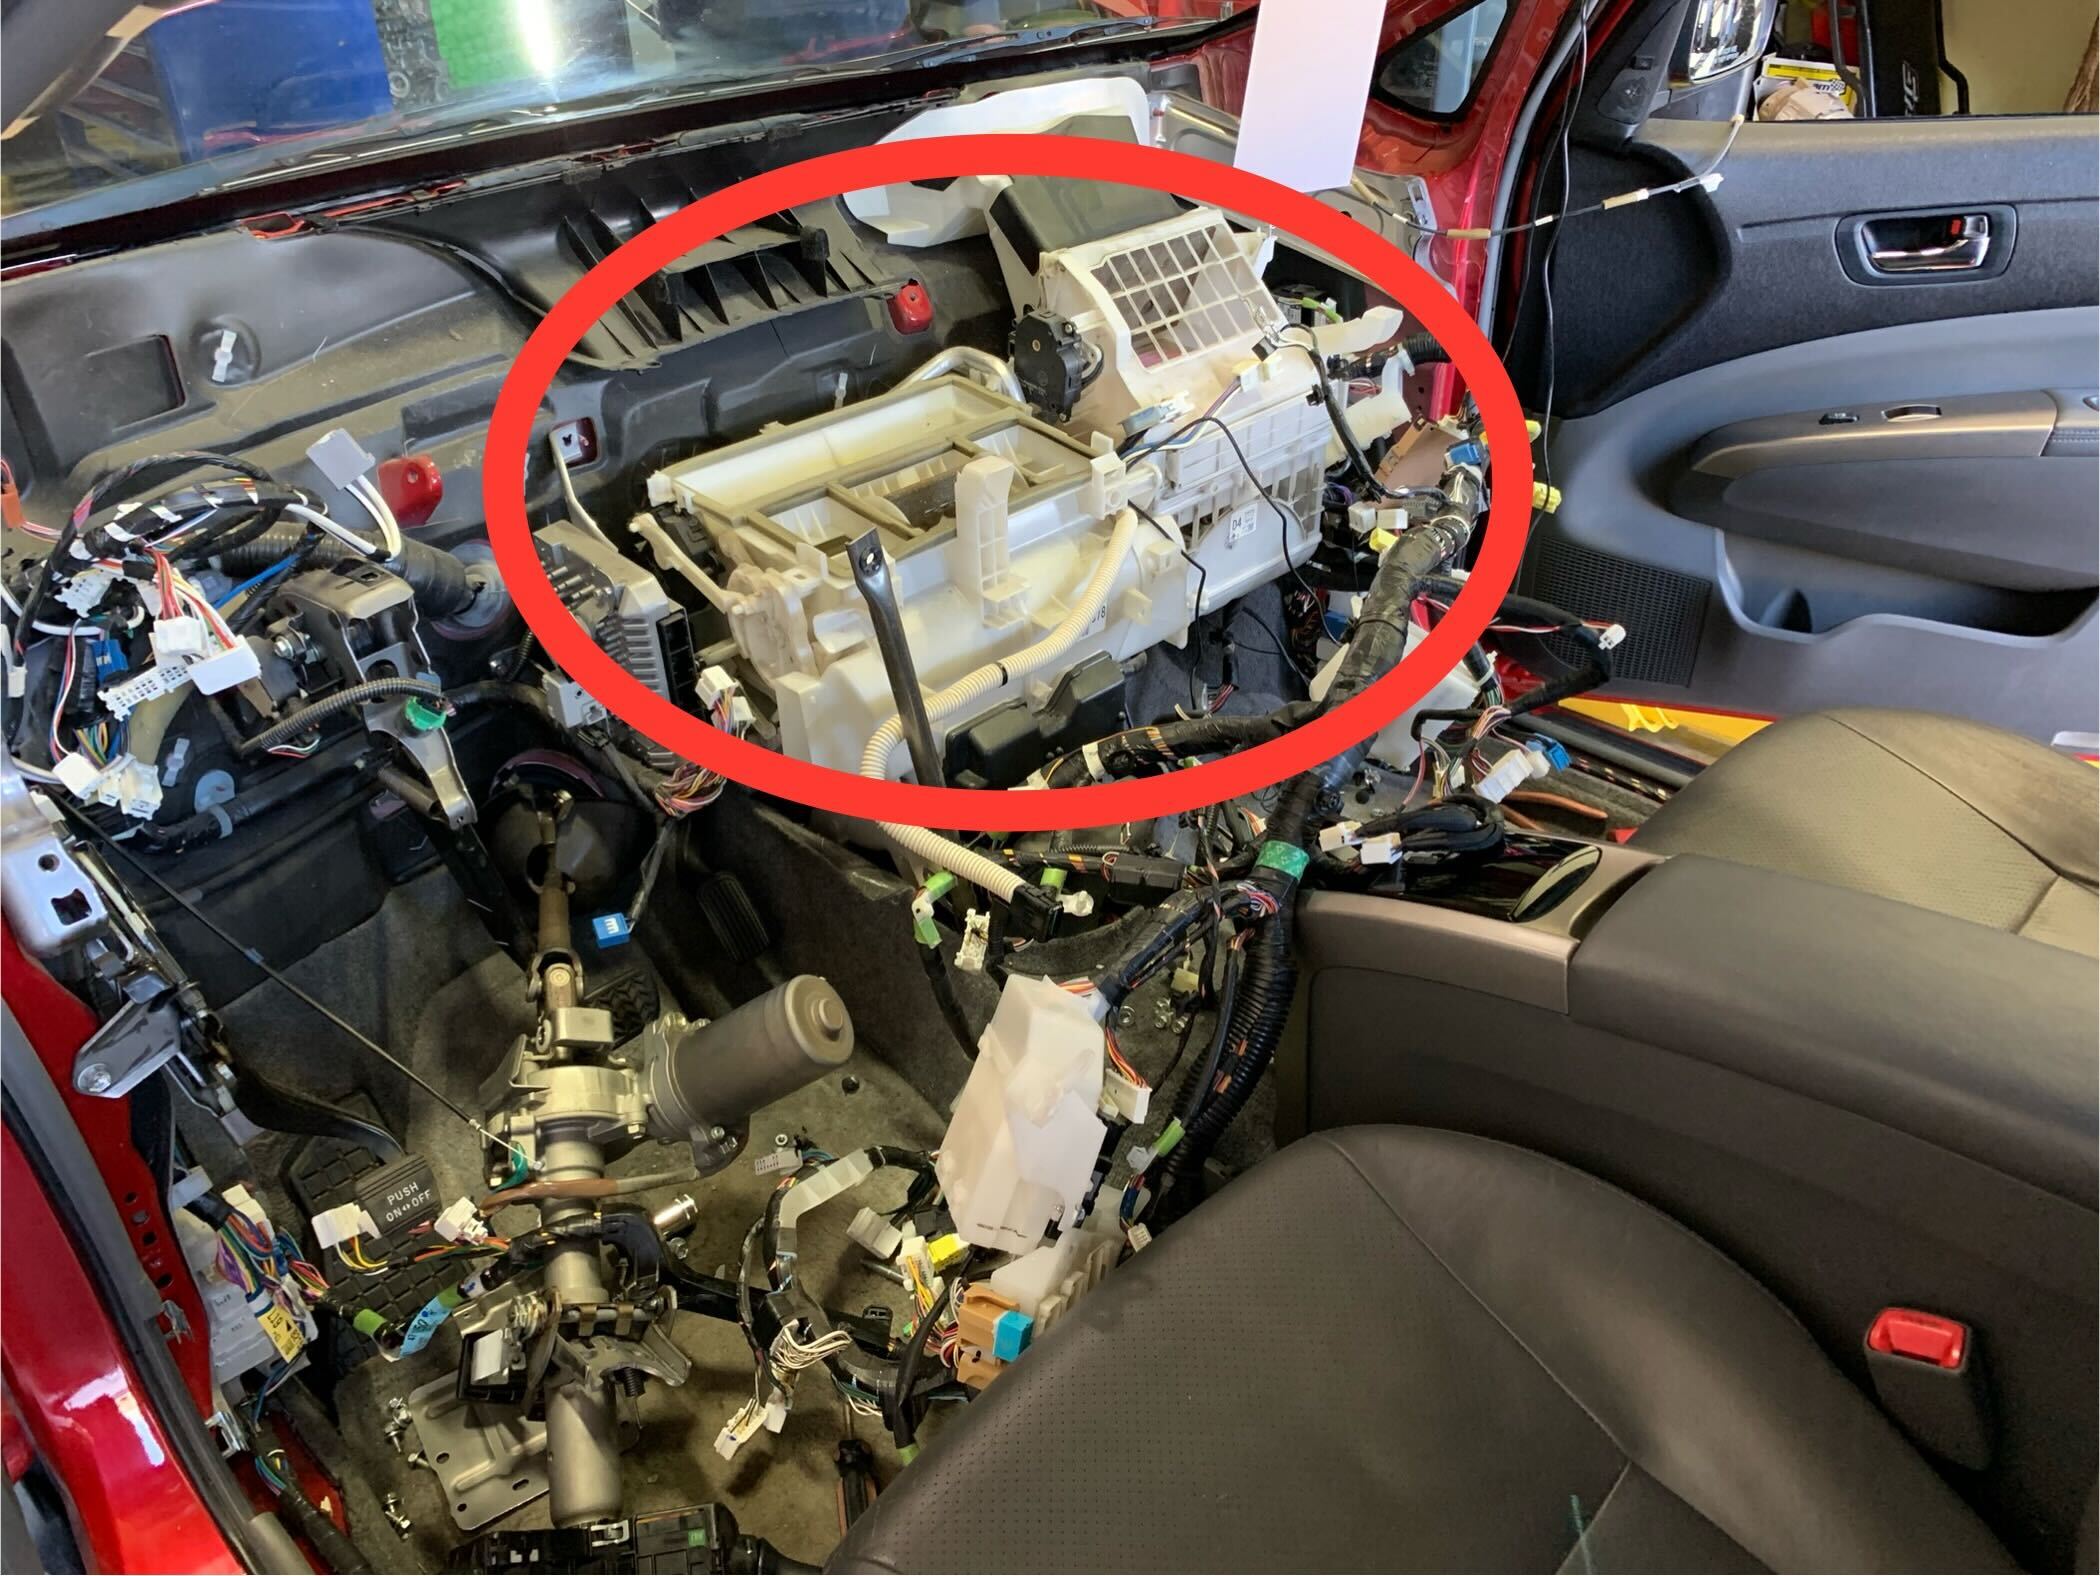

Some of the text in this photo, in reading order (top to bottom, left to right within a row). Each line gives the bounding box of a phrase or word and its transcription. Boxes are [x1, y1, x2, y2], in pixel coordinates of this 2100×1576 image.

[385, 1188, 433, 1223] ON OFF
[386, 1181, 419, 1206] PUSH
